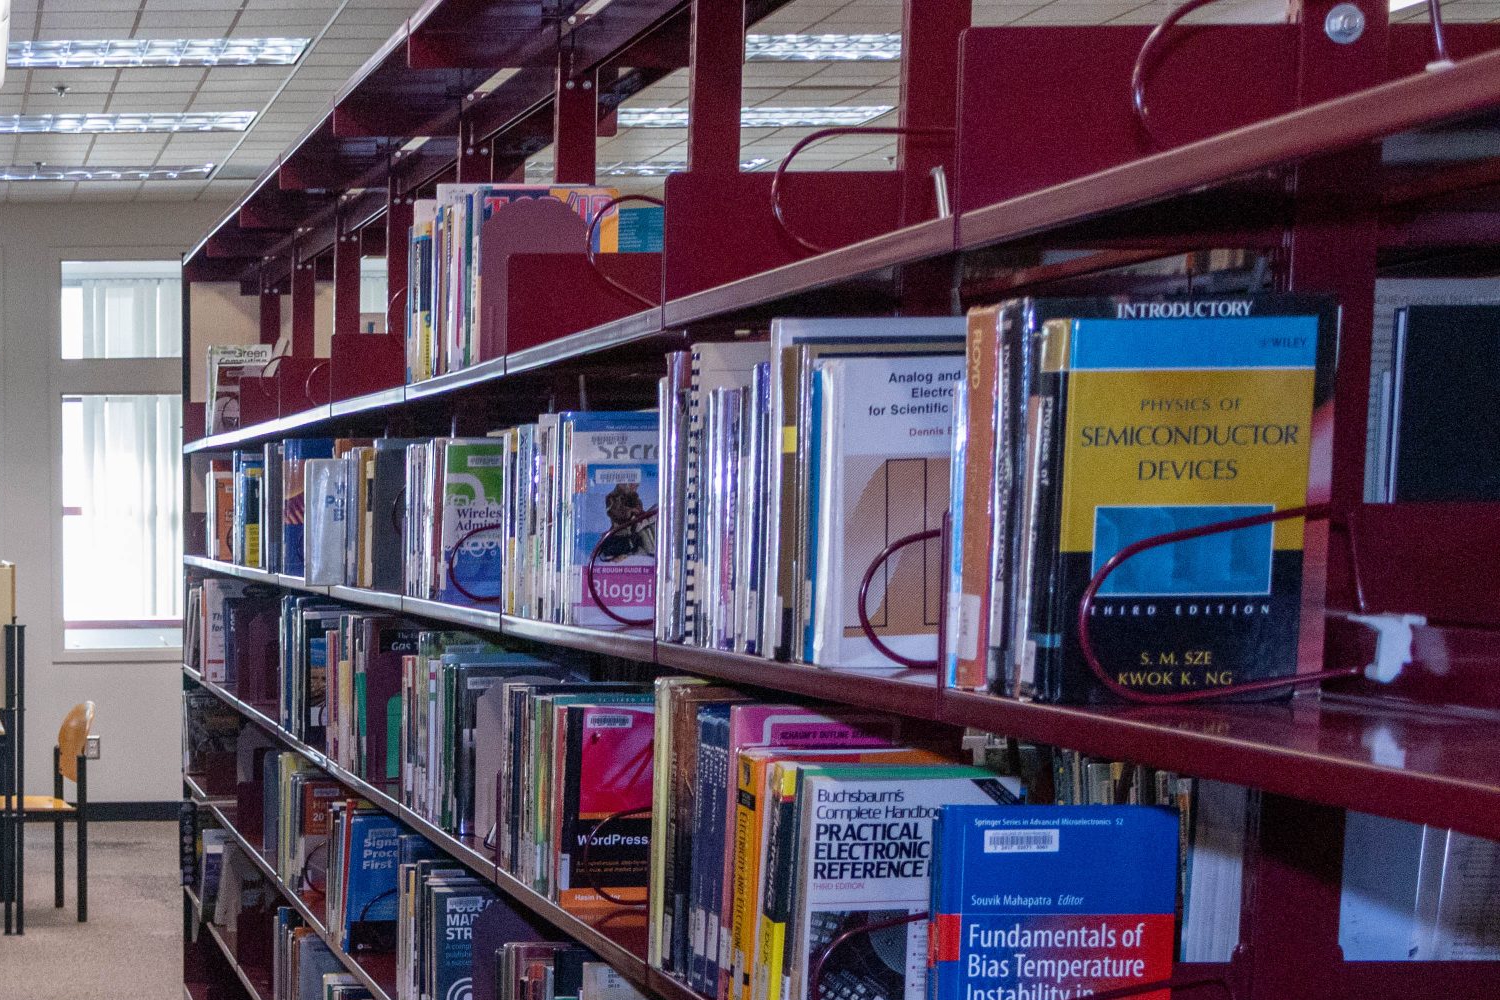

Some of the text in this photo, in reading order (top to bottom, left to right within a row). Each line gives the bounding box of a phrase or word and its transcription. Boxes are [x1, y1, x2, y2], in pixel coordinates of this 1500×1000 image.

[1116, 300, 1255, 319] INTRODUCTORY
[1271, 335, 1308, 349] WILEY
[971, 328, 983, 389] FLOYD
[889, 370, 961, 386] Analog and
[868, 402, 949, 416] for Scientific
[1140, 397, 1242, 412] PHYSICS OF
[908, 426, 944, 438] Dennis
[1080, 423, 1300, 448] SEMICONDUCTOR
[1137, 458, 1238, 482] DEVICES
[457, 508, 501, 519] Wireles
[1090, 604, 1271, 617] THIRD EDITION
[1140, 651, 1213, 667] S. M. SZE
[1117, 671, 1233, 687] KWOK K. NG
[816, 805, 882, 822] Complete
[974, 818, 1001, 827] Springer
[1002, 818, 1021, 826] Series
[1030, 818, 1060, 826] Advanced
[1061, 818, 1112, 826] Microelectronics
[815, 822, 923, 841] PRACTICAL
[577, 834, 649, 847] WordPress
[764, 805, 780, 911] Electronics
[814, 841, 930, 860] ELECTRONIC
[362, 859, 392, 870] First
[813, 860, 923, 880] REFERENCE
[812, 882, 865, 891] THIRD EDITION
[971, 894, 1084, 908] Souvik Mahapatra Editor
[968, 922, 1146, 948] Fundamentals of
[967, 954, 1144, 983] Bias Temperature
